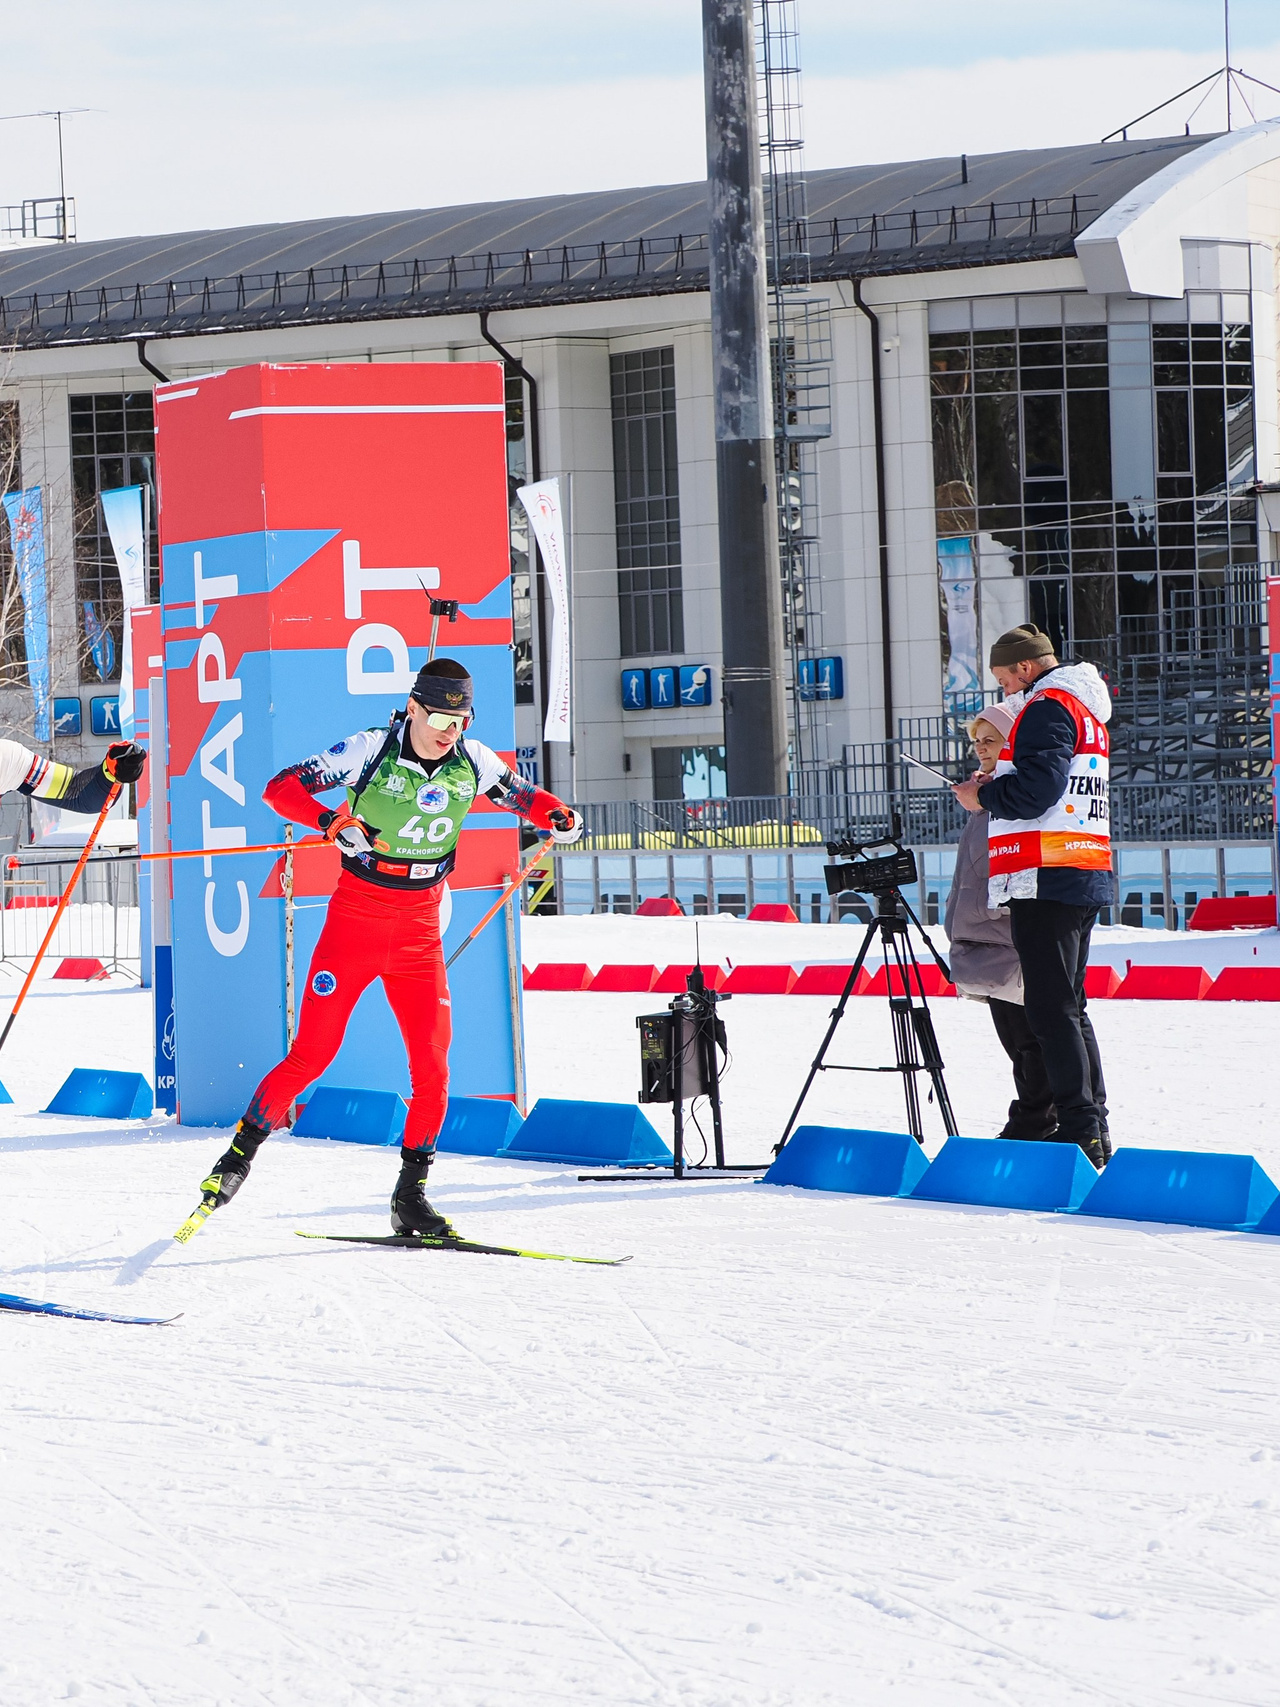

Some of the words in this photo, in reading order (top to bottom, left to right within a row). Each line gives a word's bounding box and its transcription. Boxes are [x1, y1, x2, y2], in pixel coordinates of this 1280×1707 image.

[194, 550, 249, 957] СТАРТ
[397, 815, 455, 844] 40
[396, 846, 444, 855] КРАСНОЯРСК
